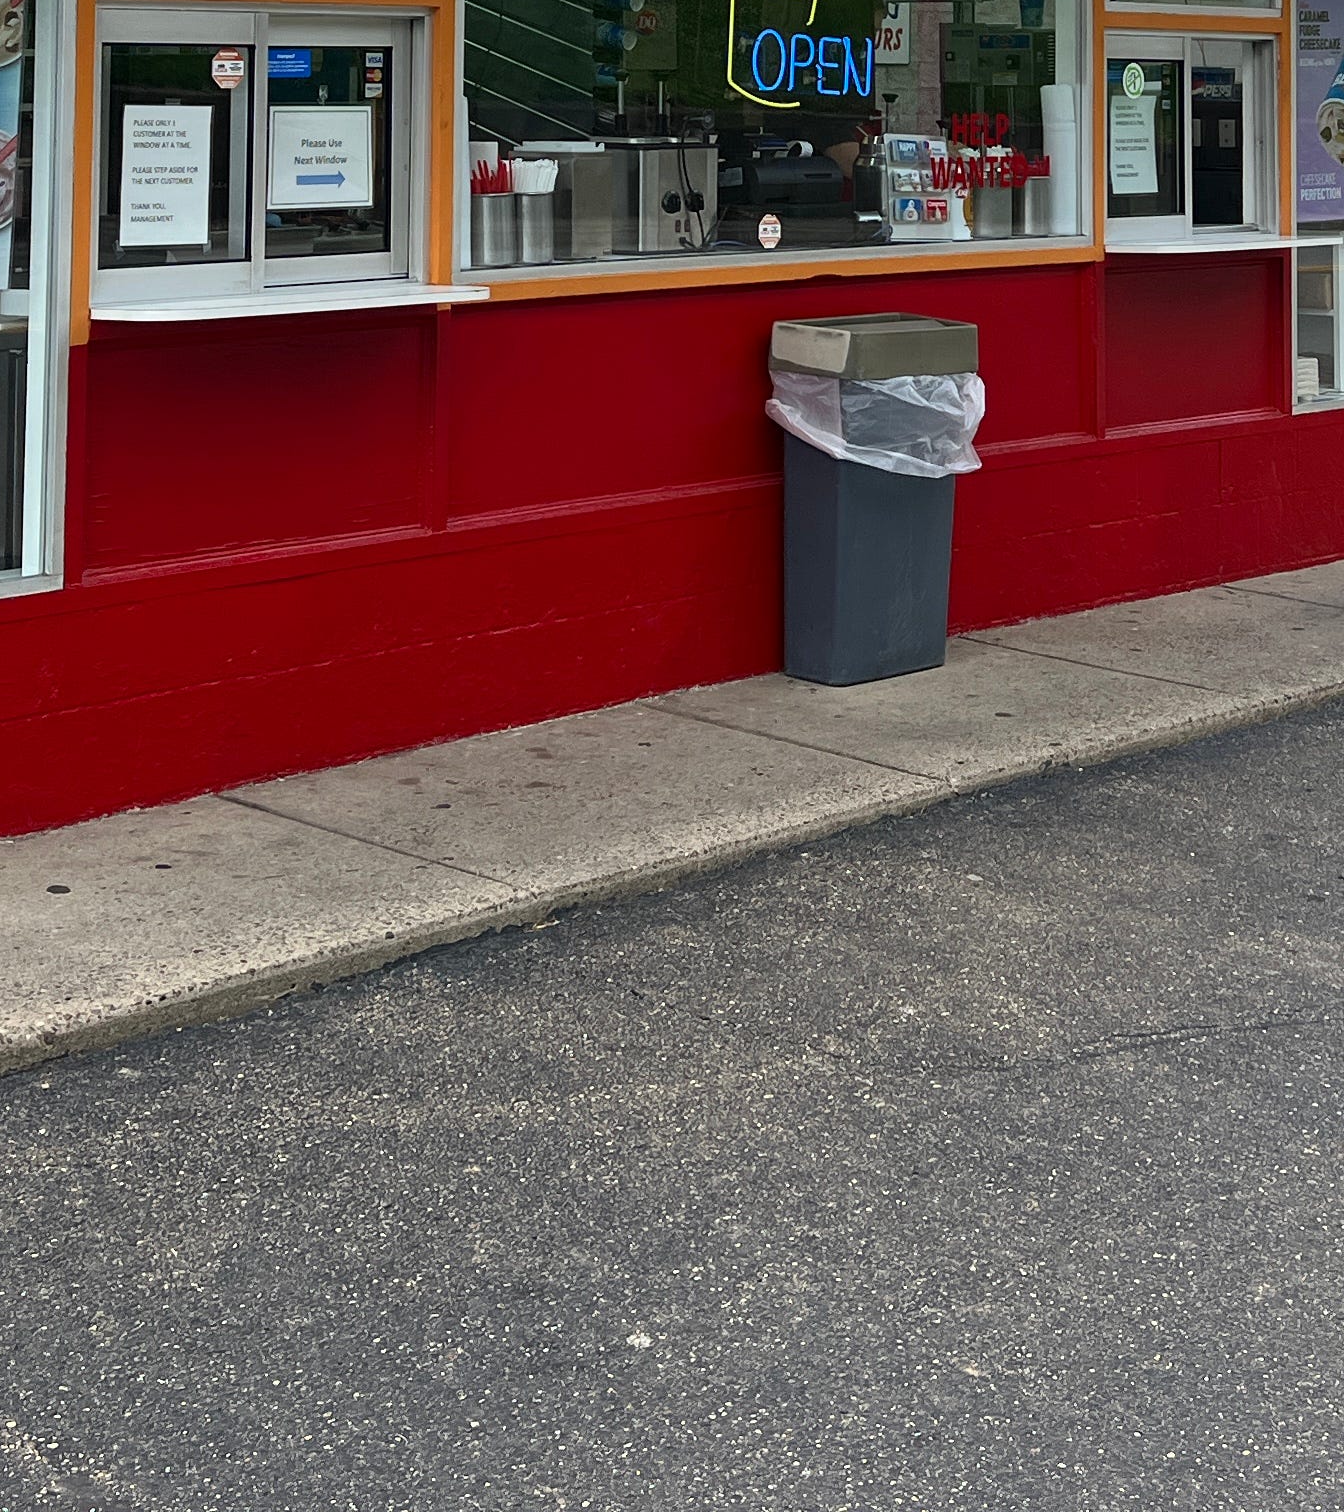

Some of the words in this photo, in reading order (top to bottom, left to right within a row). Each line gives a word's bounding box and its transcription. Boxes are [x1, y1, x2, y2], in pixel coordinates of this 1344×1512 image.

[638, 15, 657, 31] DQ
[1299, 10, 1330, 23] CARAMEL
[1299, 24, 1321, 37] FUDGE
[1299, 38, 1342, 51] CHEESECAKE
[367, 55, 383, 64] VISA
[751, 28, 875, 97] OPEN
[132, 130, 166, 138] CUSTOMER
[951, 112, 1011, 147] HELP
[133, 141, 160, 149] WINDOW
[301, 138, 327, 148] Please
[328, 138, 343, 148] Use
[294, 156, 314, 165] Next
[315, 155, 348, 165] Window
[131, 166, 153, 174] PLEASE
[153, 166, 168, 174] STEP
[168, 166, 186, 174] ASIDE
[930, 155, 1028, 191] WANTED
[131, 177, 144, 185] THE
[1300, 172, 1337, 186] CHEESECAKE
[1300, 187, 1343, 201] PERFECTION
[130, 215, 175, 223] MANAGEMENT
